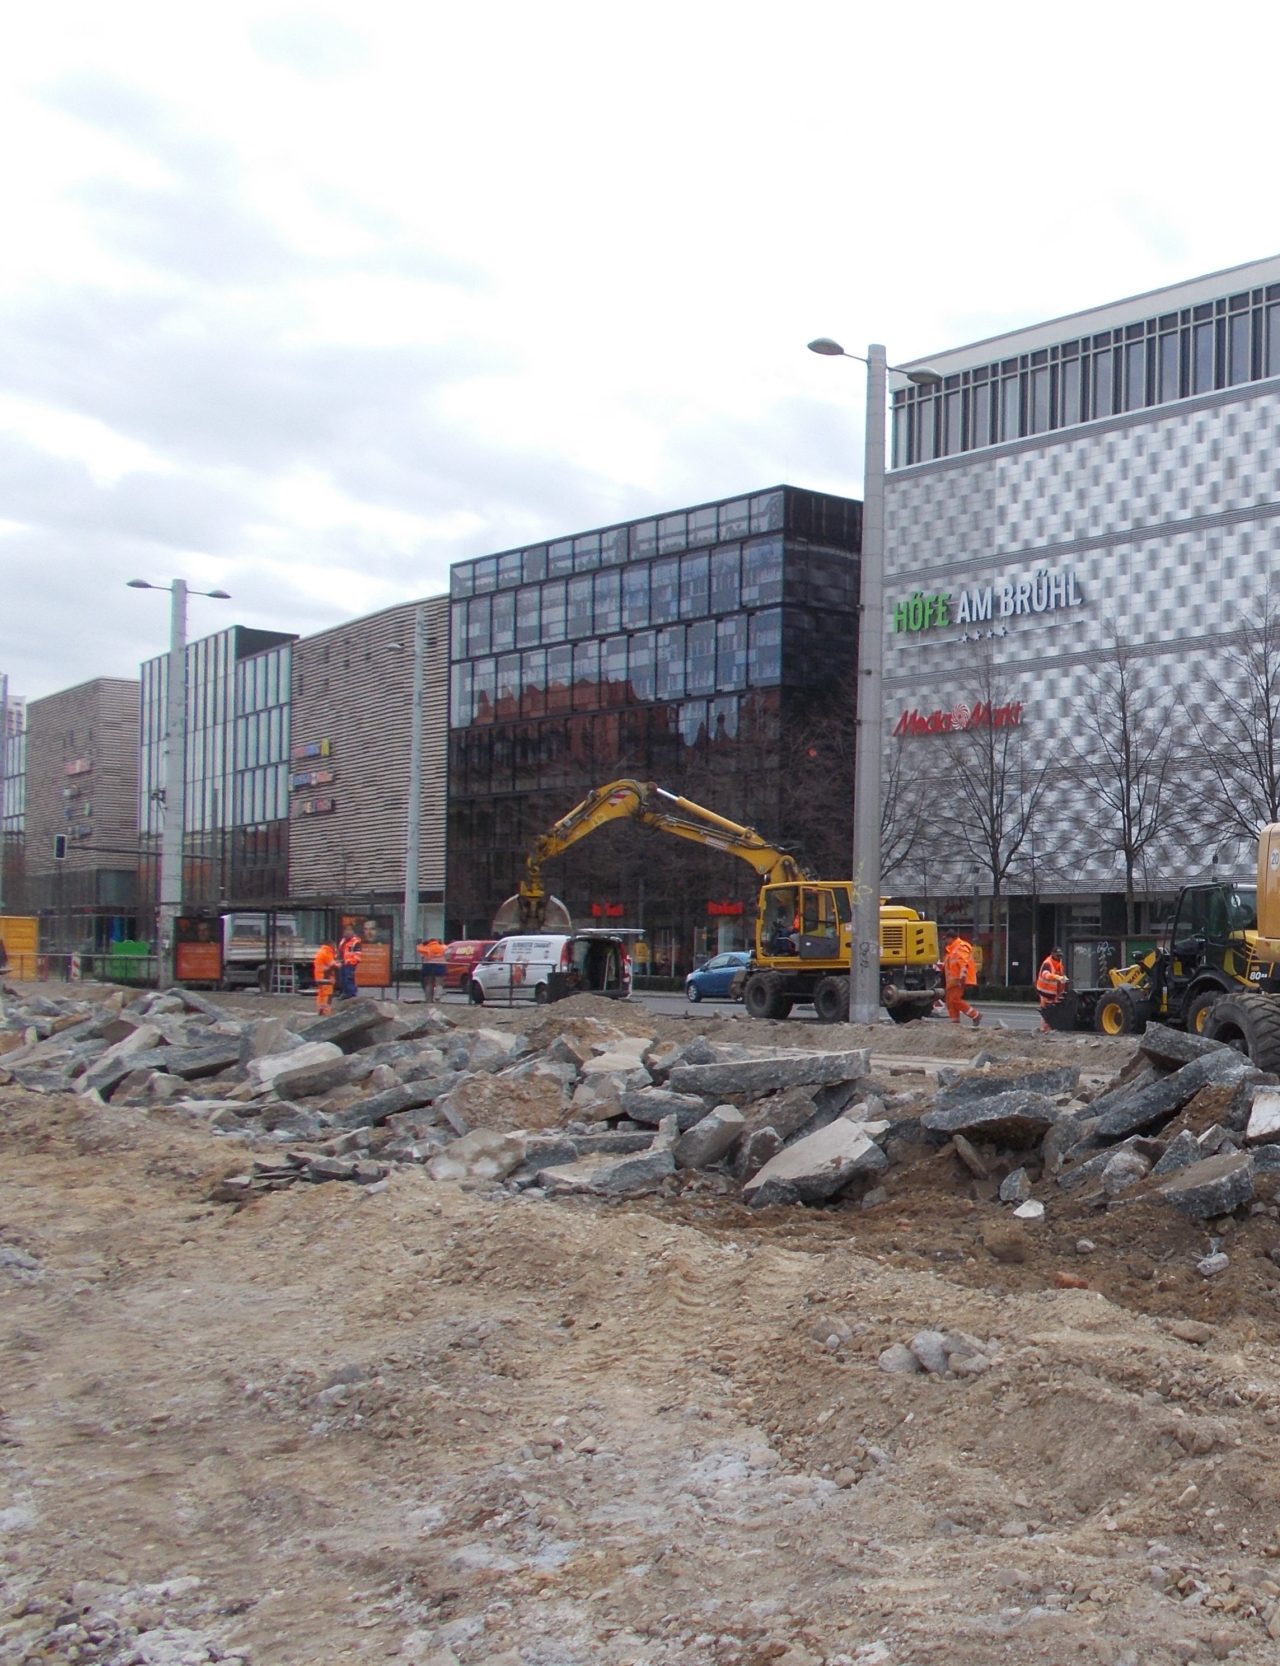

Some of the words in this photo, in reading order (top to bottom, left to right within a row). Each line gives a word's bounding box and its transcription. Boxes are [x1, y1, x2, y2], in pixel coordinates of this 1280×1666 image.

[894, 591, 952, 633] HÖFE
[956, 586, 993, 624] AM
[1001, 570, 1083, 617] BRÜHL
